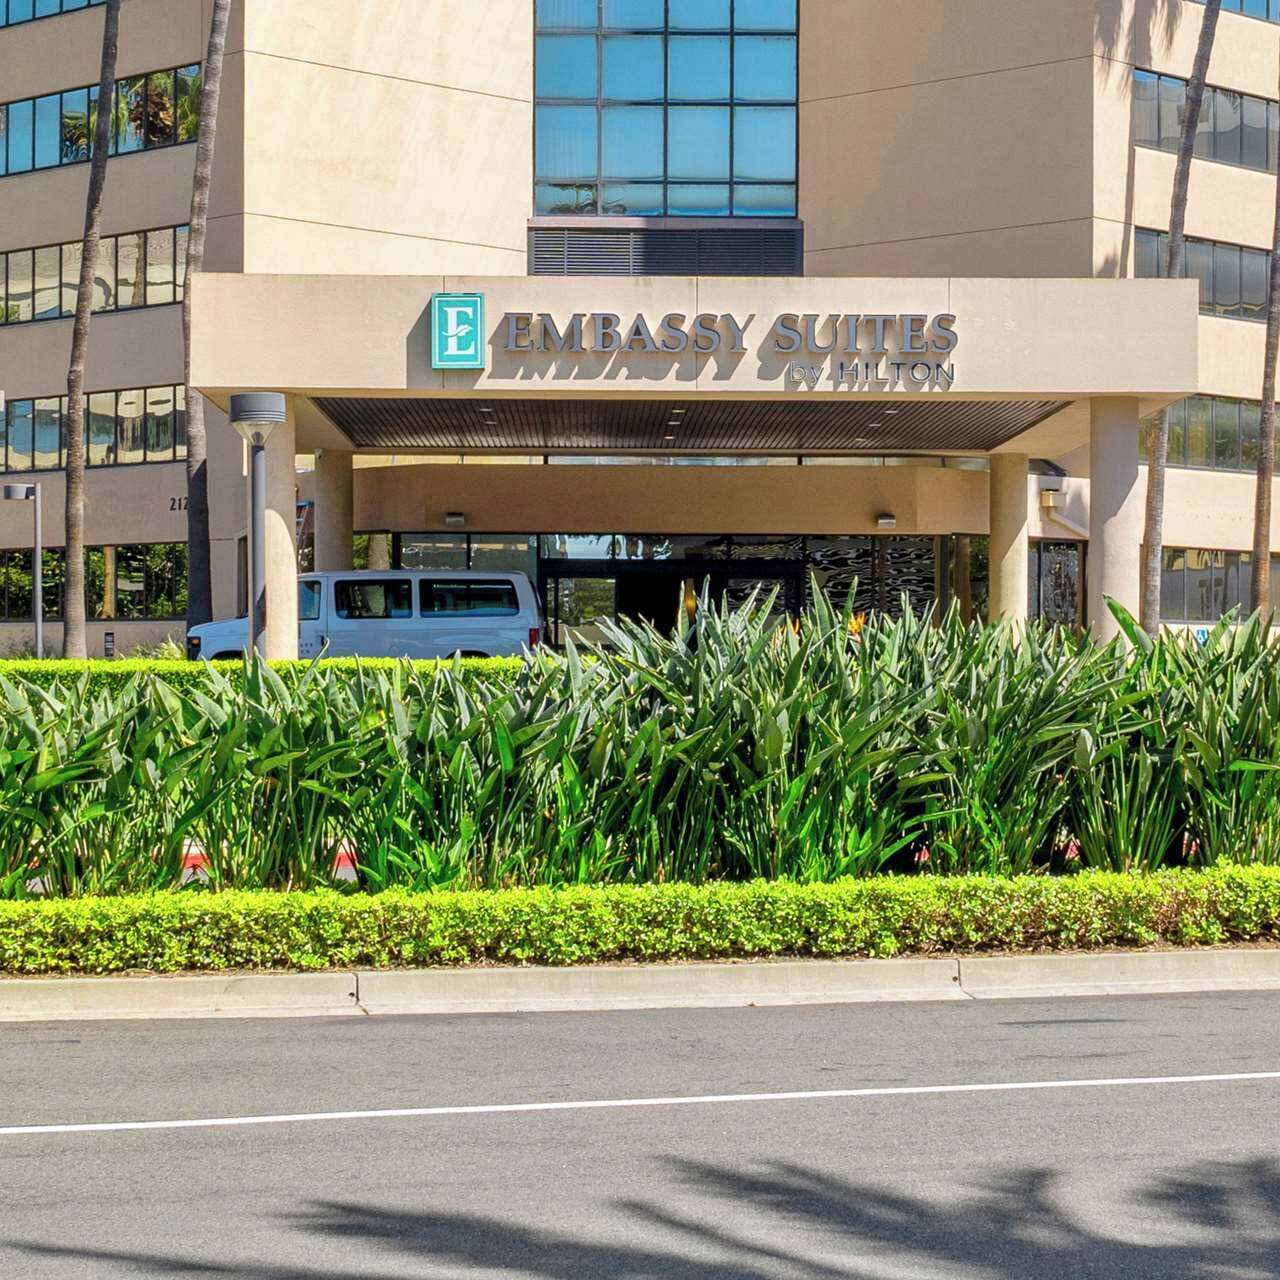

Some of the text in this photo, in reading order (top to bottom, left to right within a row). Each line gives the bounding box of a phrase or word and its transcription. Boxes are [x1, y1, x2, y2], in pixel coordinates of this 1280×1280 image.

[503, 312, 756, 353] EMBASSY
[774, 313, 959, 353] SUITES
[790, 360, 955, 388] by HILTON
